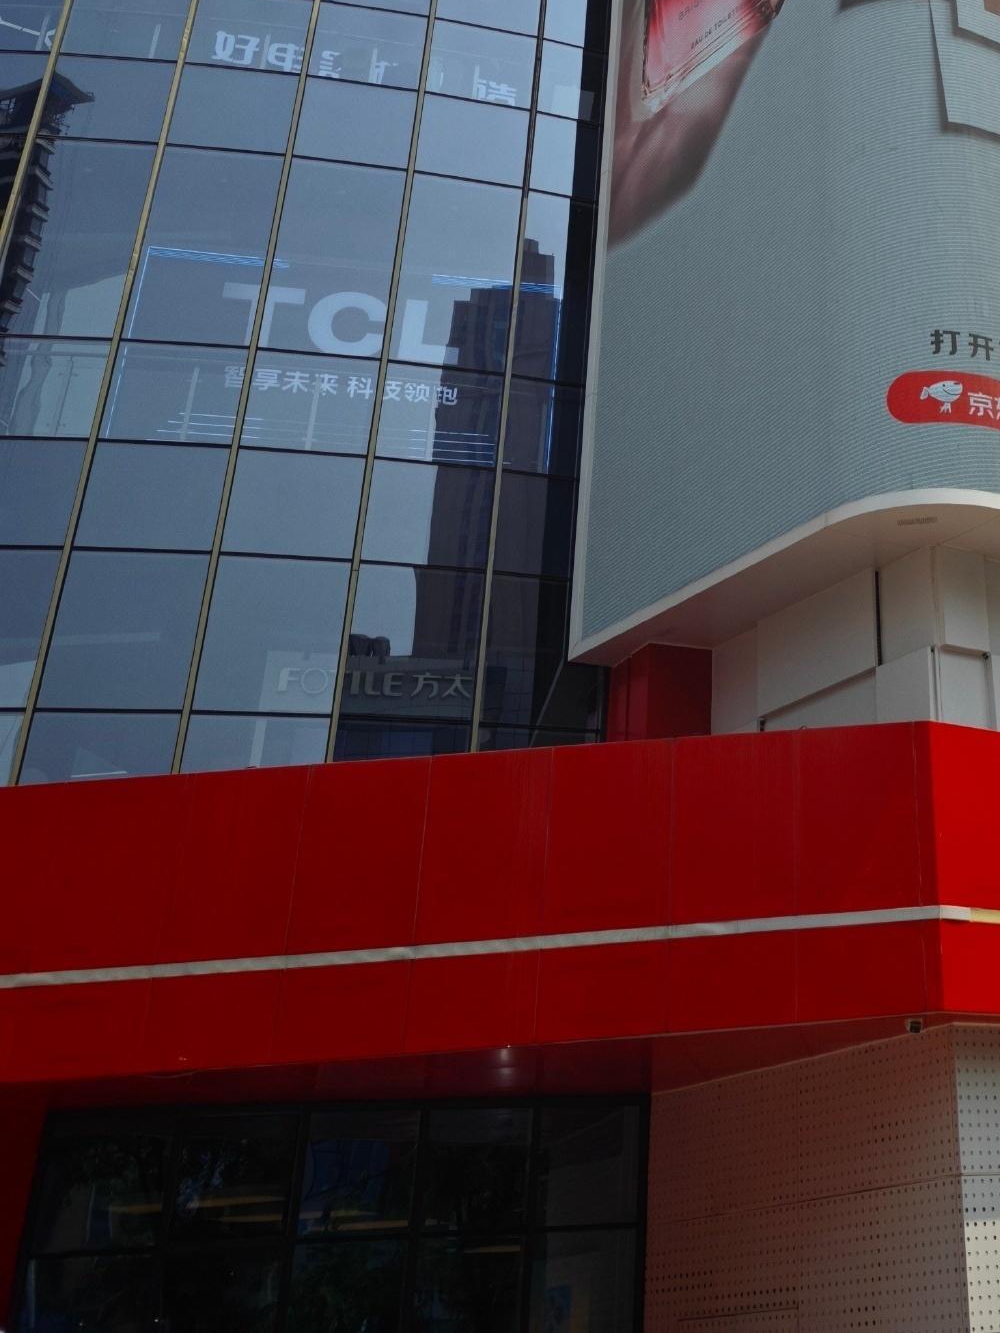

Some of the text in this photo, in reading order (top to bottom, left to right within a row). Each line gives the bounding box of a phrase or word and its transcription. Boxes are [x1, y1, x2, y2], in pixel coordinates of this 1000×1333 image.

[222, 282, 459, 365] TCL
[224, 366, 338, 396] 智享未来
[410, 671, 473, 699] 方太
